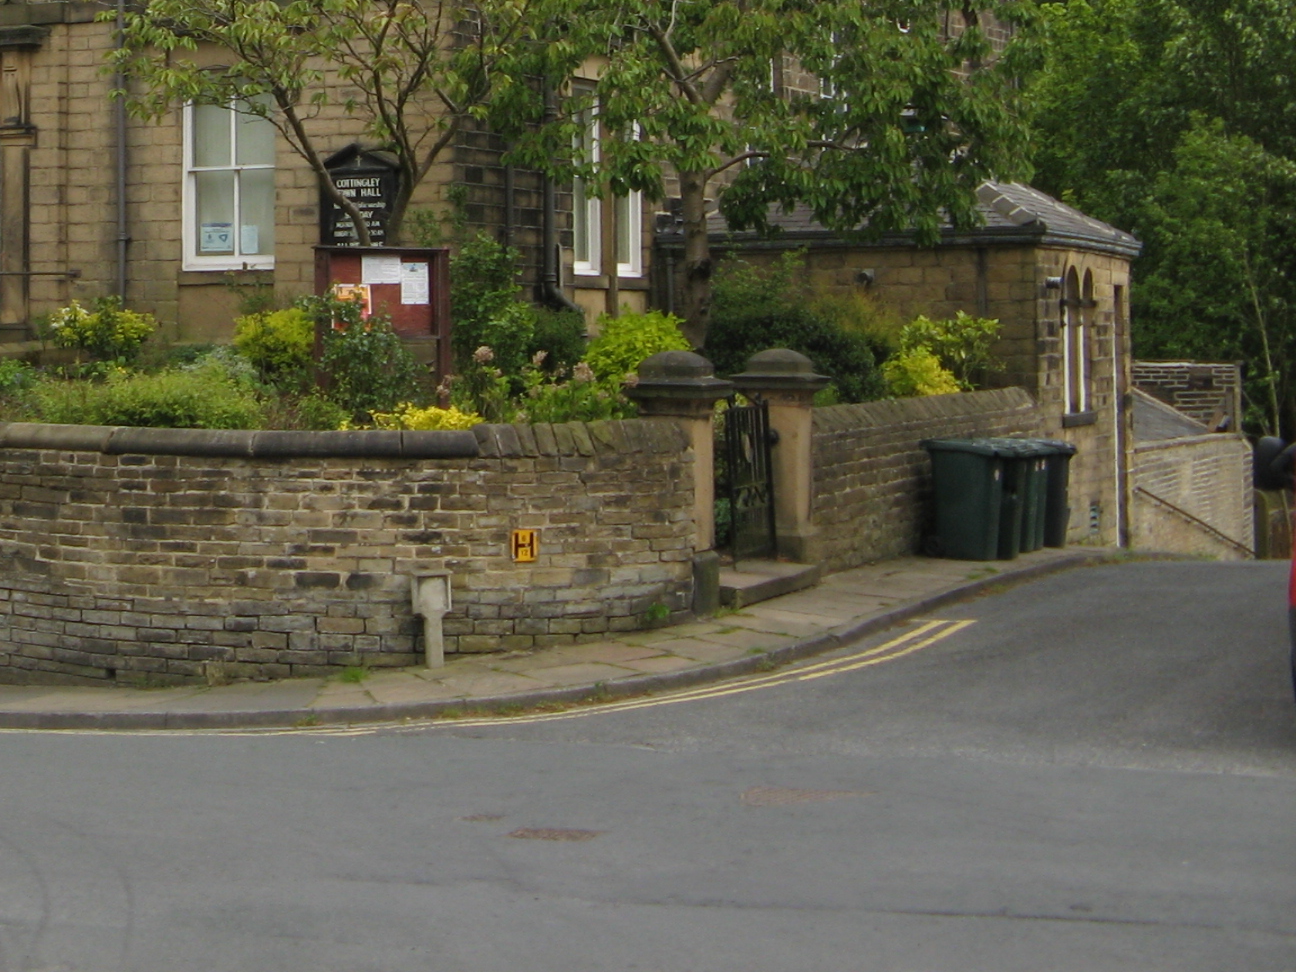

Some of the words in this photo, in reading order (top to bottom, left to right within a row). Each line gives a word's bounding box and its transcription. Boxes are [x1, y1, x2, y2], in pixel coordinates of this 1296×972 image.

[336, 178, 381, 188] COTTINGLEY
[360, 188, 381, 197] HALL
[514, 532, 534, 558] H
